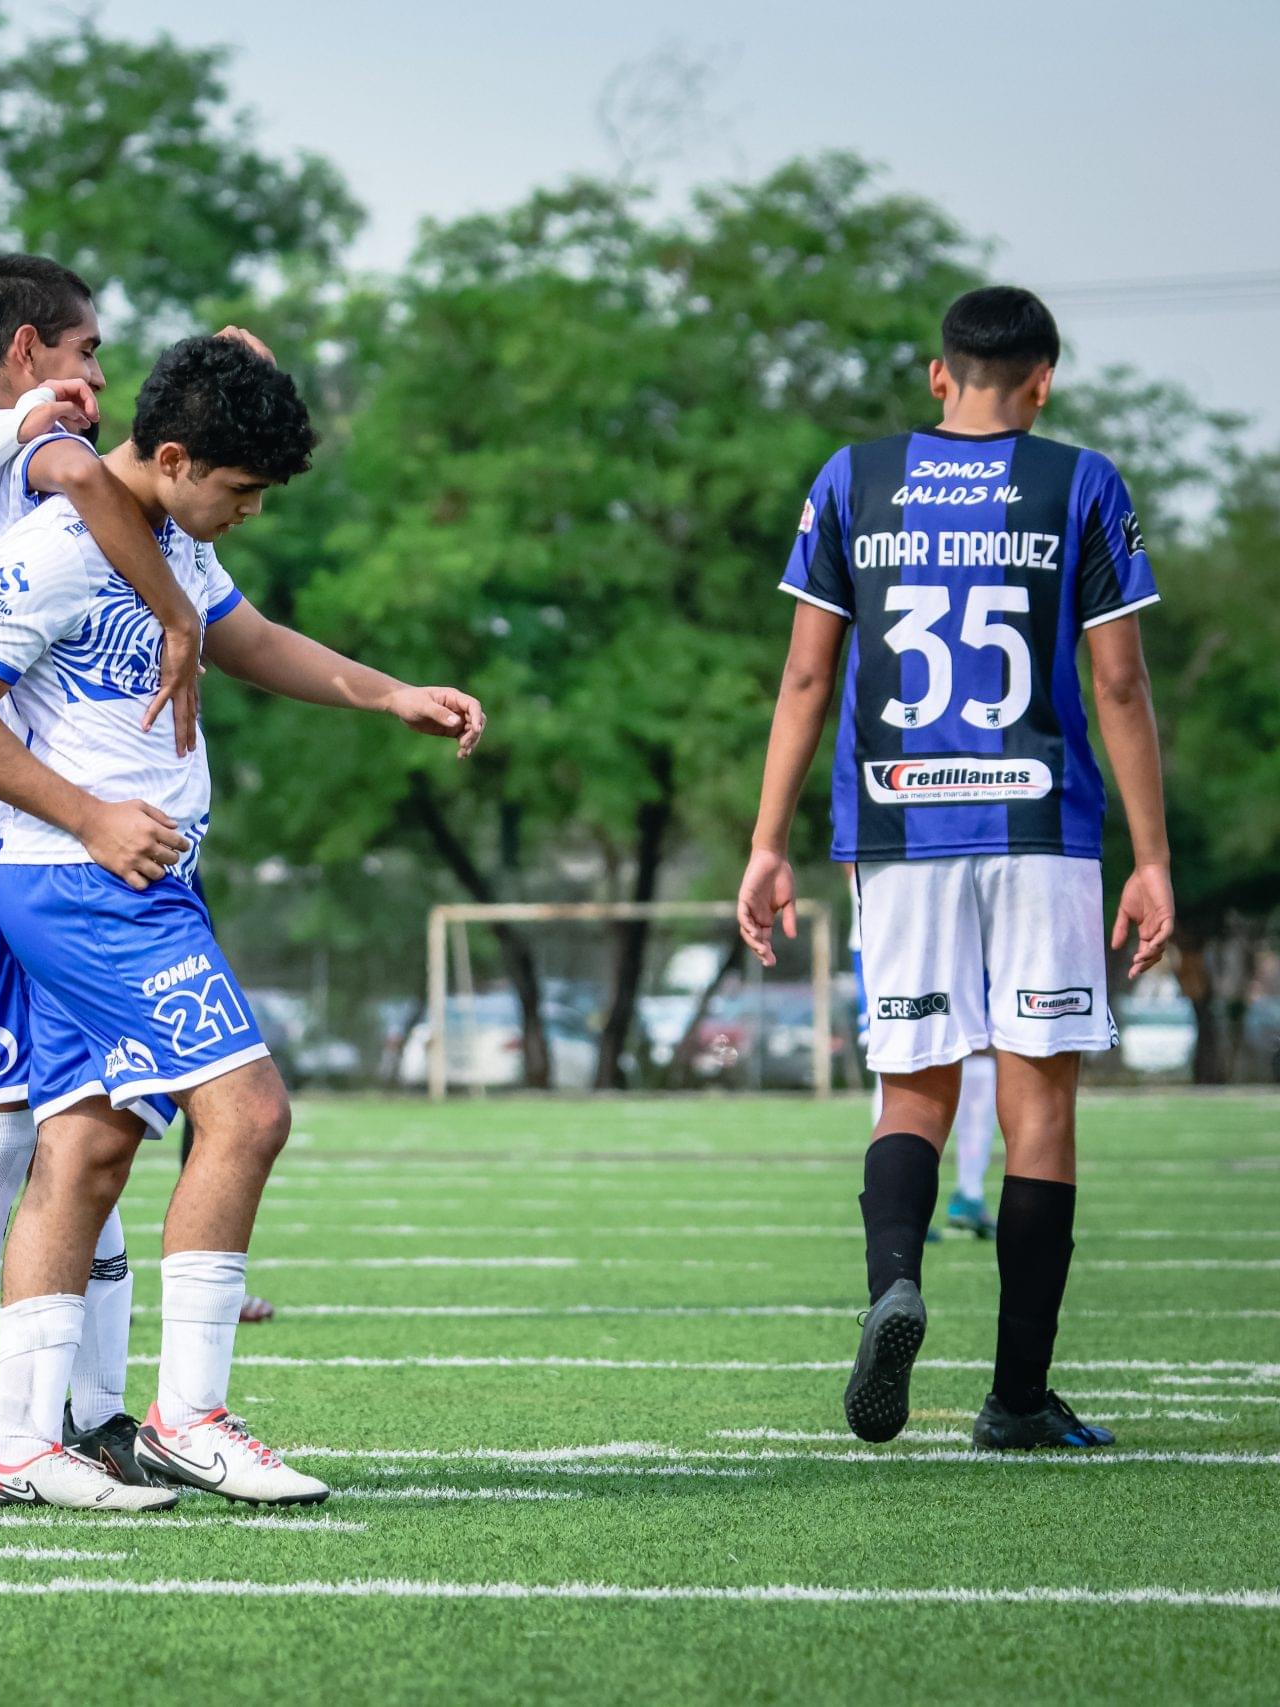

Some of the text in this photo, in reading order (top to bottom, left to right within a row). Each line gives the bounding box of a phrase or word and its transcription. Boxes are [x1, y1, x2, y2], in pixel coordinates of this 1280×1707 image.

[910, 460, 1007, 479] SOMOS
[891, 485, 1022, 506] GALLOS NL
[854, 530, 1060, 570] OMAR ENRIQUEZ
[880, 584, 1032, 730] 35
[141, 953, 212, 997] CONIKA
[152, 973, 250, 1058] 21
